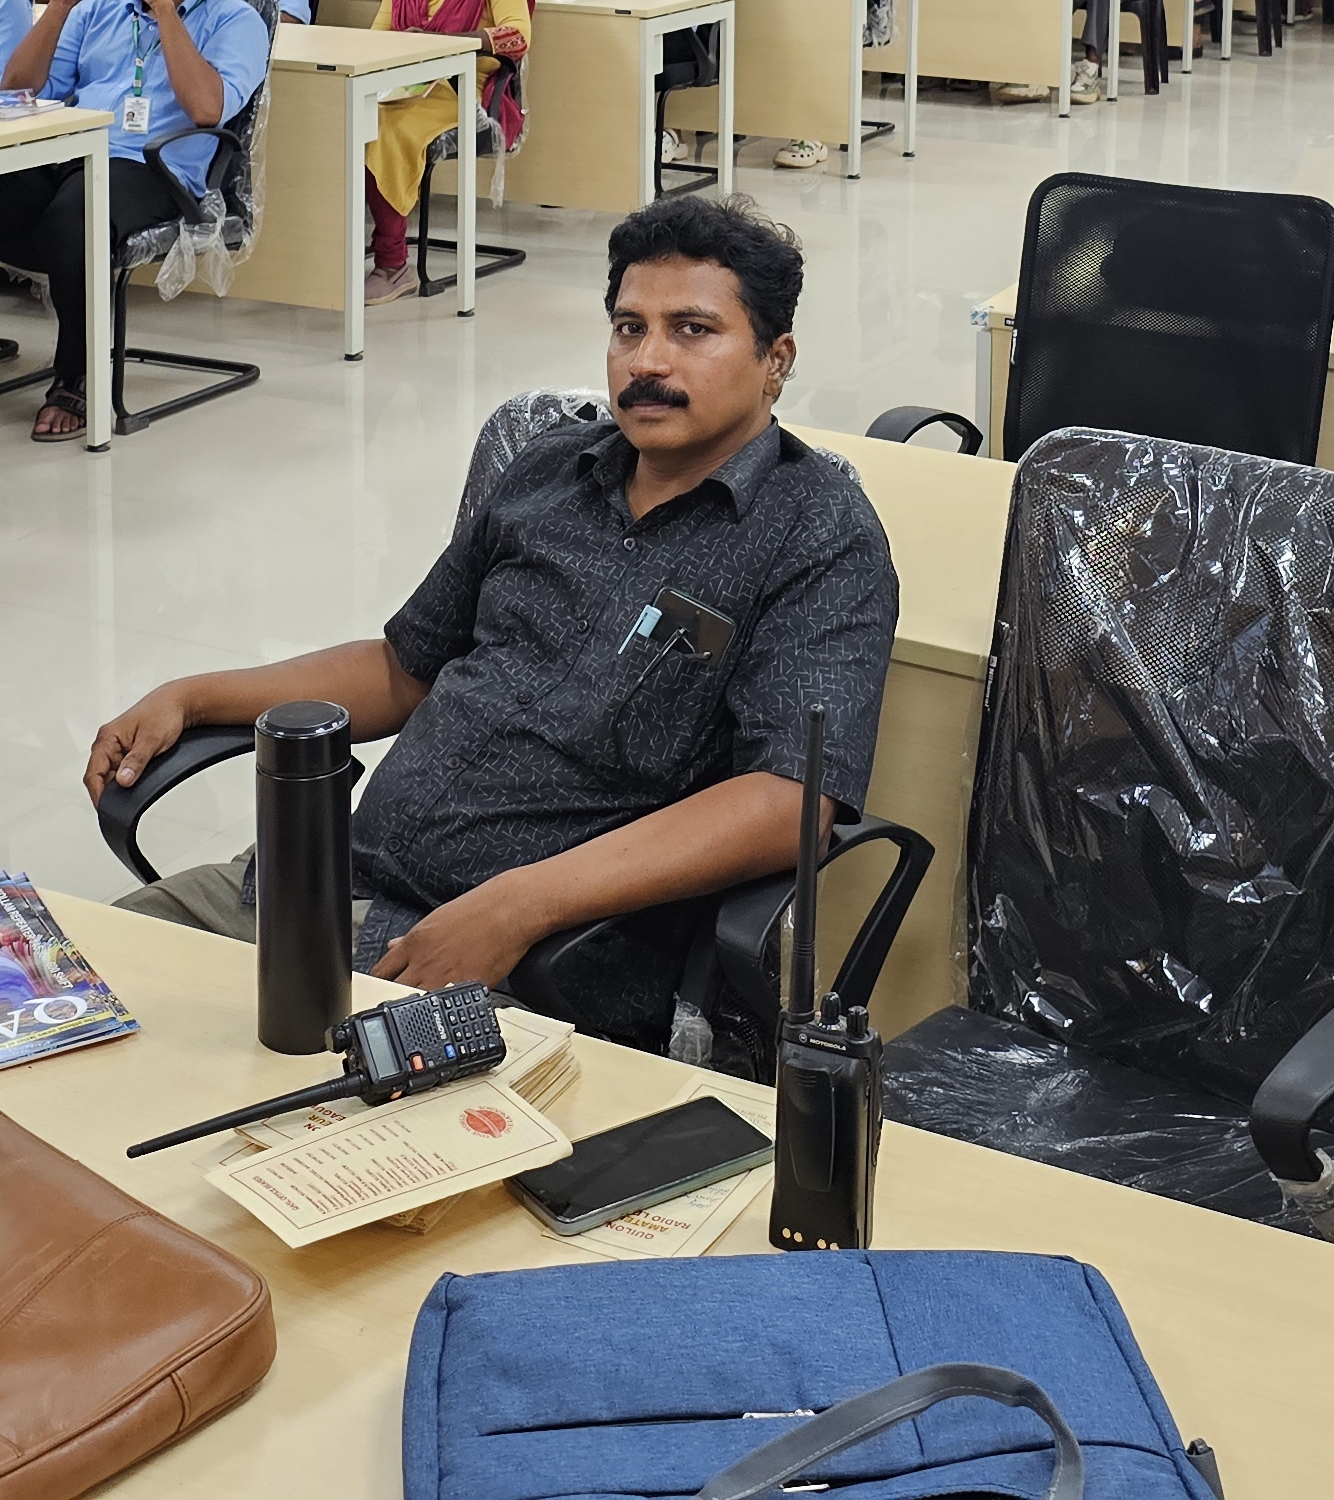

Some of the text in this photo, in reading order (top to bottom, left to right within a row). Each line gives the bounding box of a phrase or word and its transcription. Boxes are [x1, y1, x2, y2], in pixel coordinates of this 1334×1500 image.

[9, 909, 36, 942] REPEATER
[54, 972, 74, 989] SHIFT
[809, 1038, 847, 1051] MOTOROLA
[604, 1220, 655, 1240] QUILON
[652, 1214, 691, 1230] RADIO
